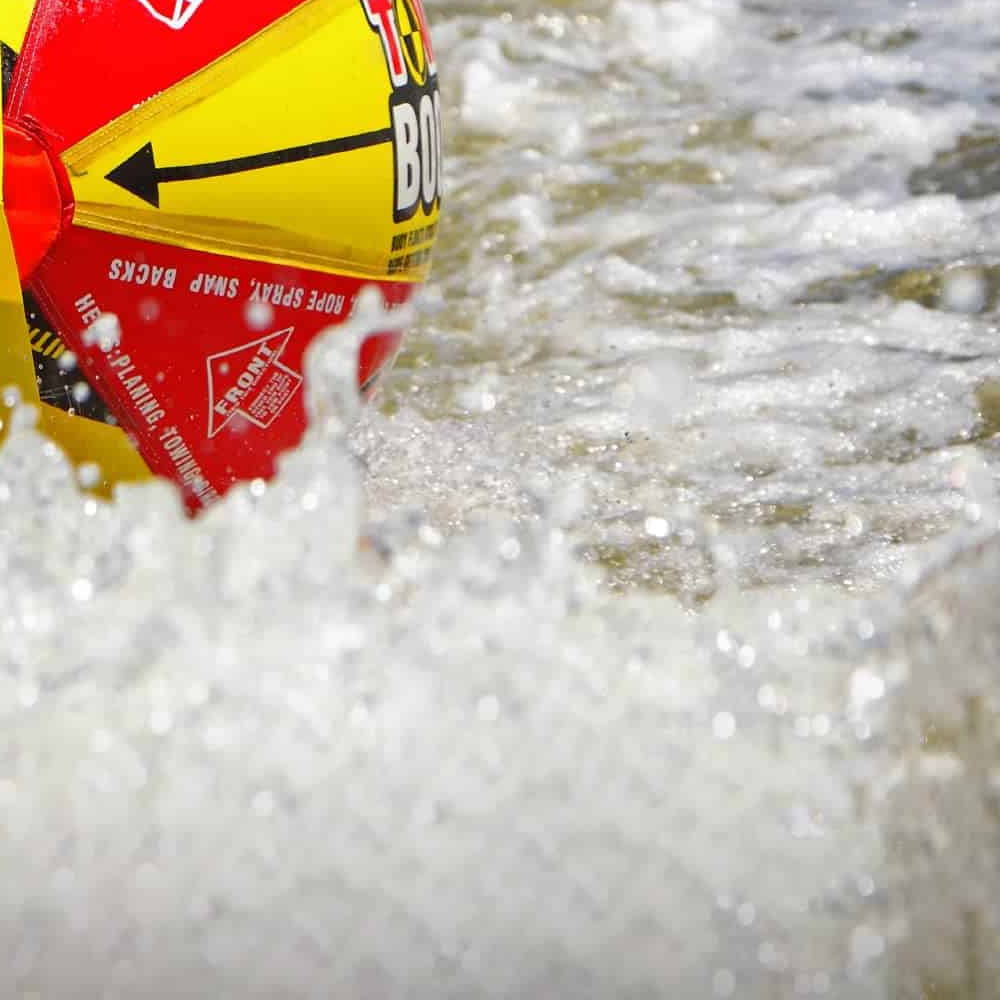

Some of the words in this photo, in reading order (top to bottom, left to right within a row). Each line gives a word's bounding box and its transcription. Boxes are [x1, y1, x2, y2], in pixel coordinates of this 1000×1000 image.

[108, 258, 177, 289] BACKS
[189, 272, 240, 299] SNAP
[250, 278, 304, 309] SPRAY,
[306, 290, 344, 316] ROPE
[213, 341, 278, 417] FRONT
